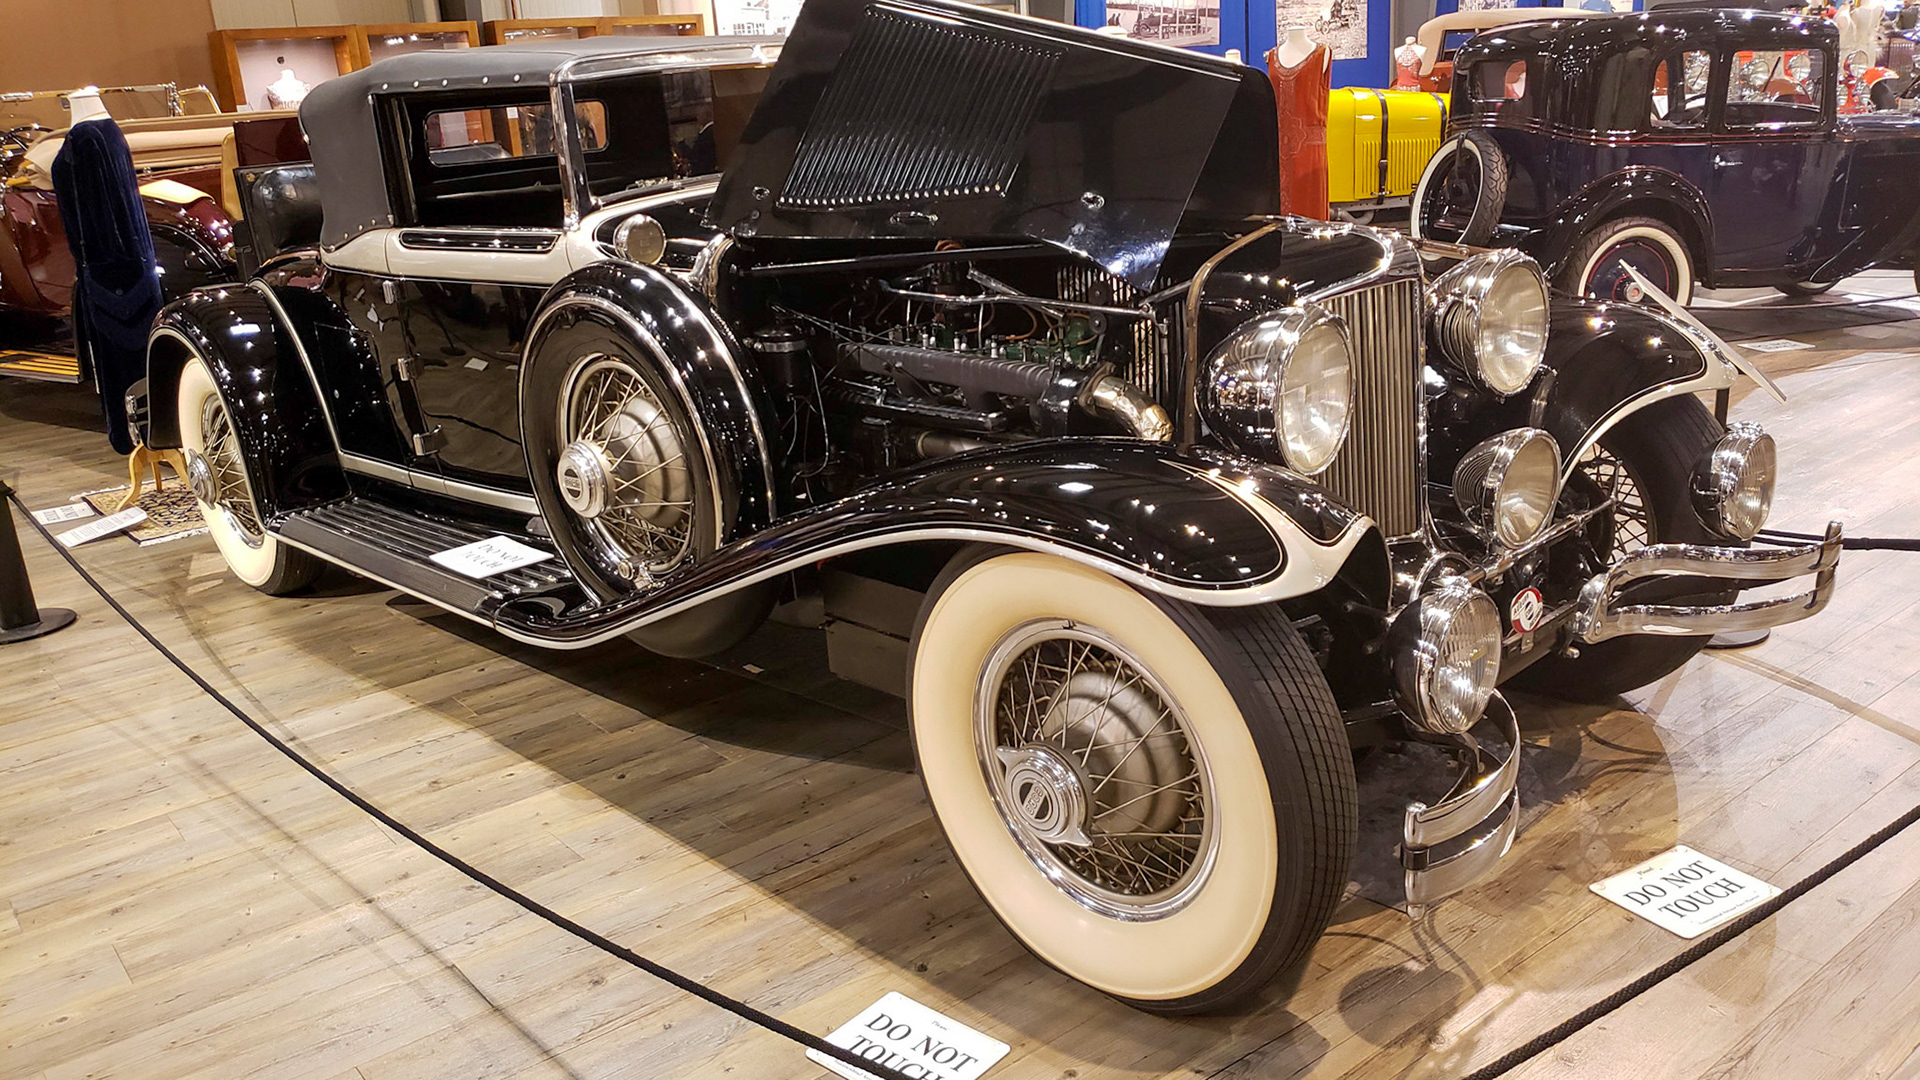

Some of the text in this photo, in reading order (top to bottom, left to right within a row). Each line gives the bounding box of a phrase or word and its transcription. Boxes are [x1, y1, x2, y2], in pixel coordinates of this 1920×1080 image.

[1623, 860, 1716, 906] DO NOT
[1658, 878, 1746, 919] TOUCH
[865, 1013, 912, 1041] DO
[911, 1035, 979, 1073] NOT
